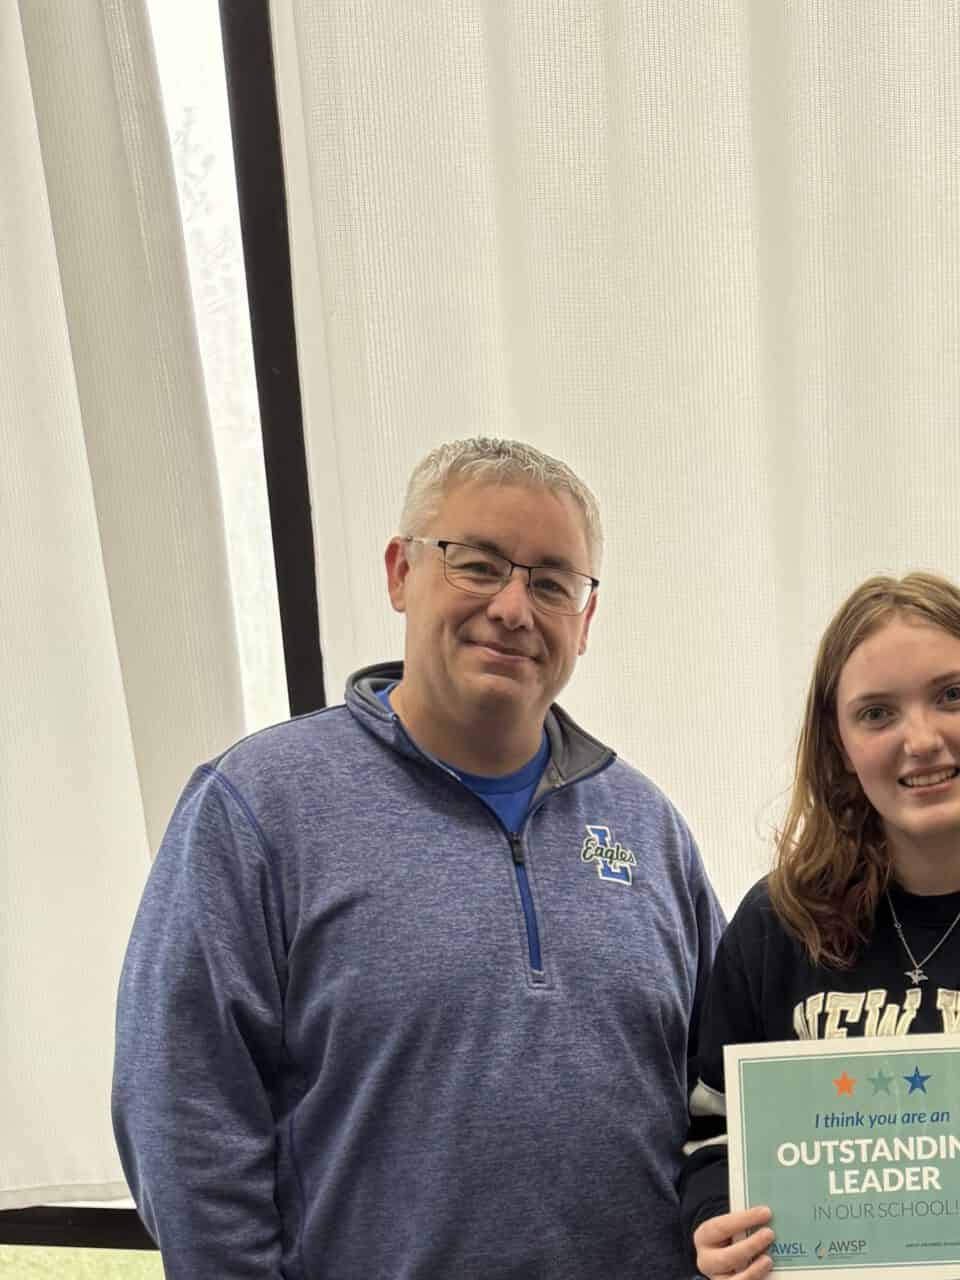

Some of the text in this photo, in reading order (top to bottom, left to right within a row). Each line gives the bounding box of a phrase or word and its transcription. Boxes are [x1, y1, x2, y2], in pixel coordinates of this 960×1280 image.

[582, 836, 637, 872] Eagles
[815, 1111, 951, 1129] I think you are an
[828, 1166, 942, 1195] LEADER
[812, 1200, 960, 1221] IN OUR SCHOOL!
[828, 1240, 867, 1254] AWSP
